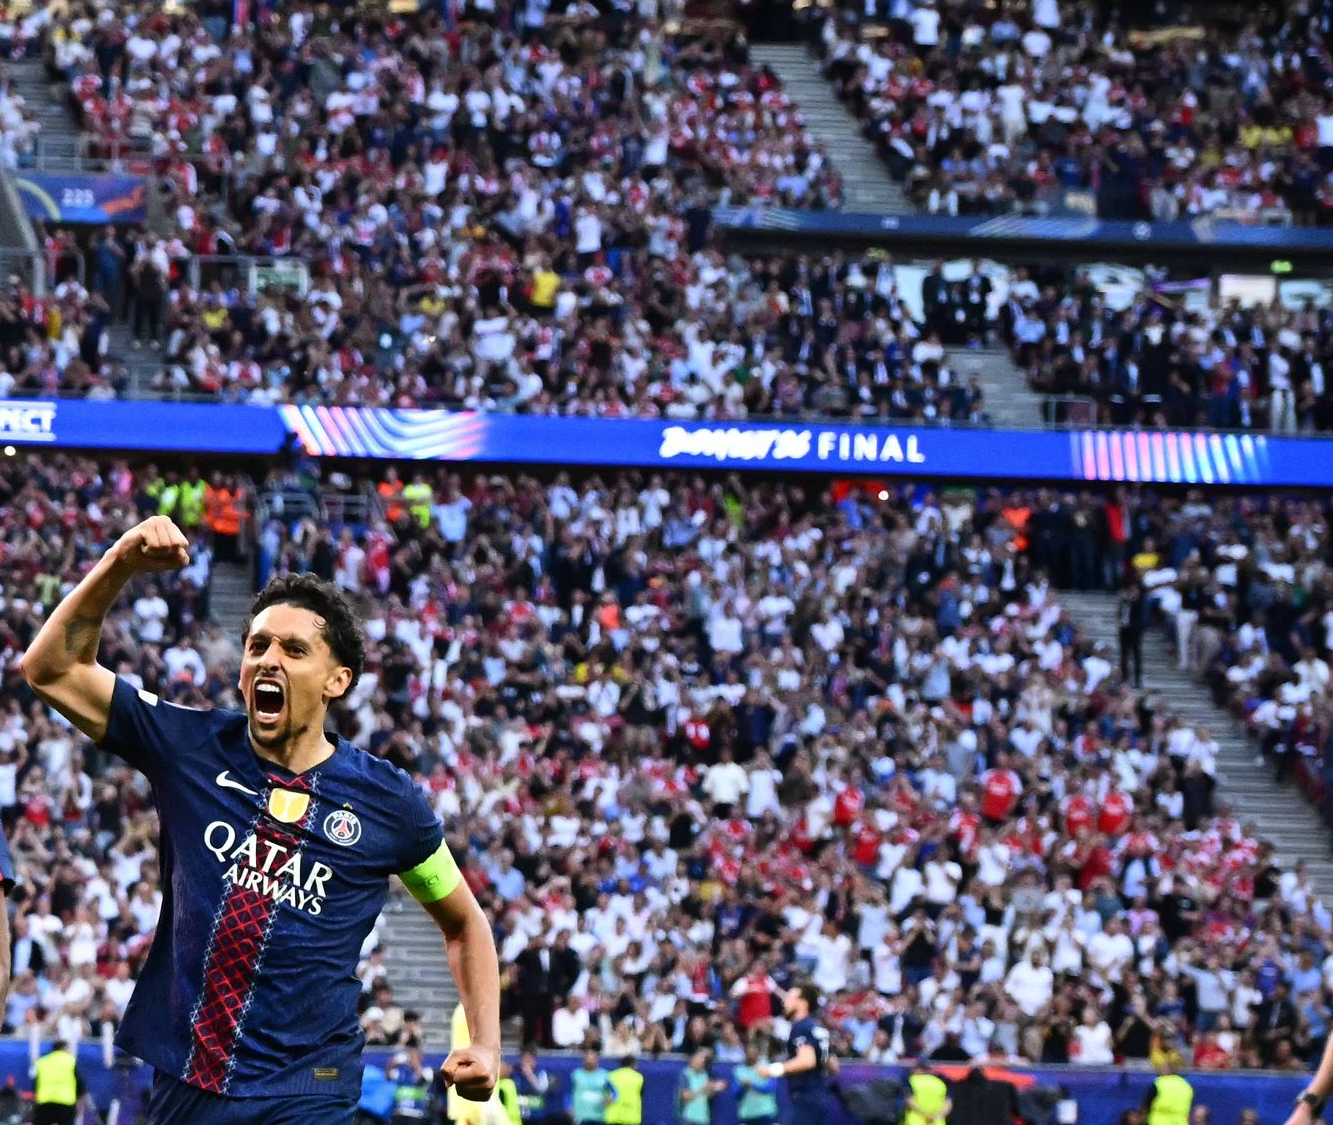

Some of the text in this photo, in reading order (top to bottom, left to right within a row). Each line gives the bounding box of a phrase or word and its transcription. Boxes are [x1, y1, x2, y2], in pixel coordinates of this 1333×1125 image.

[818, 432, 925, 463] FINAL
[204, 821, 333, 897] QATAR
[222, 863, 323, 915] AIRWAYS
